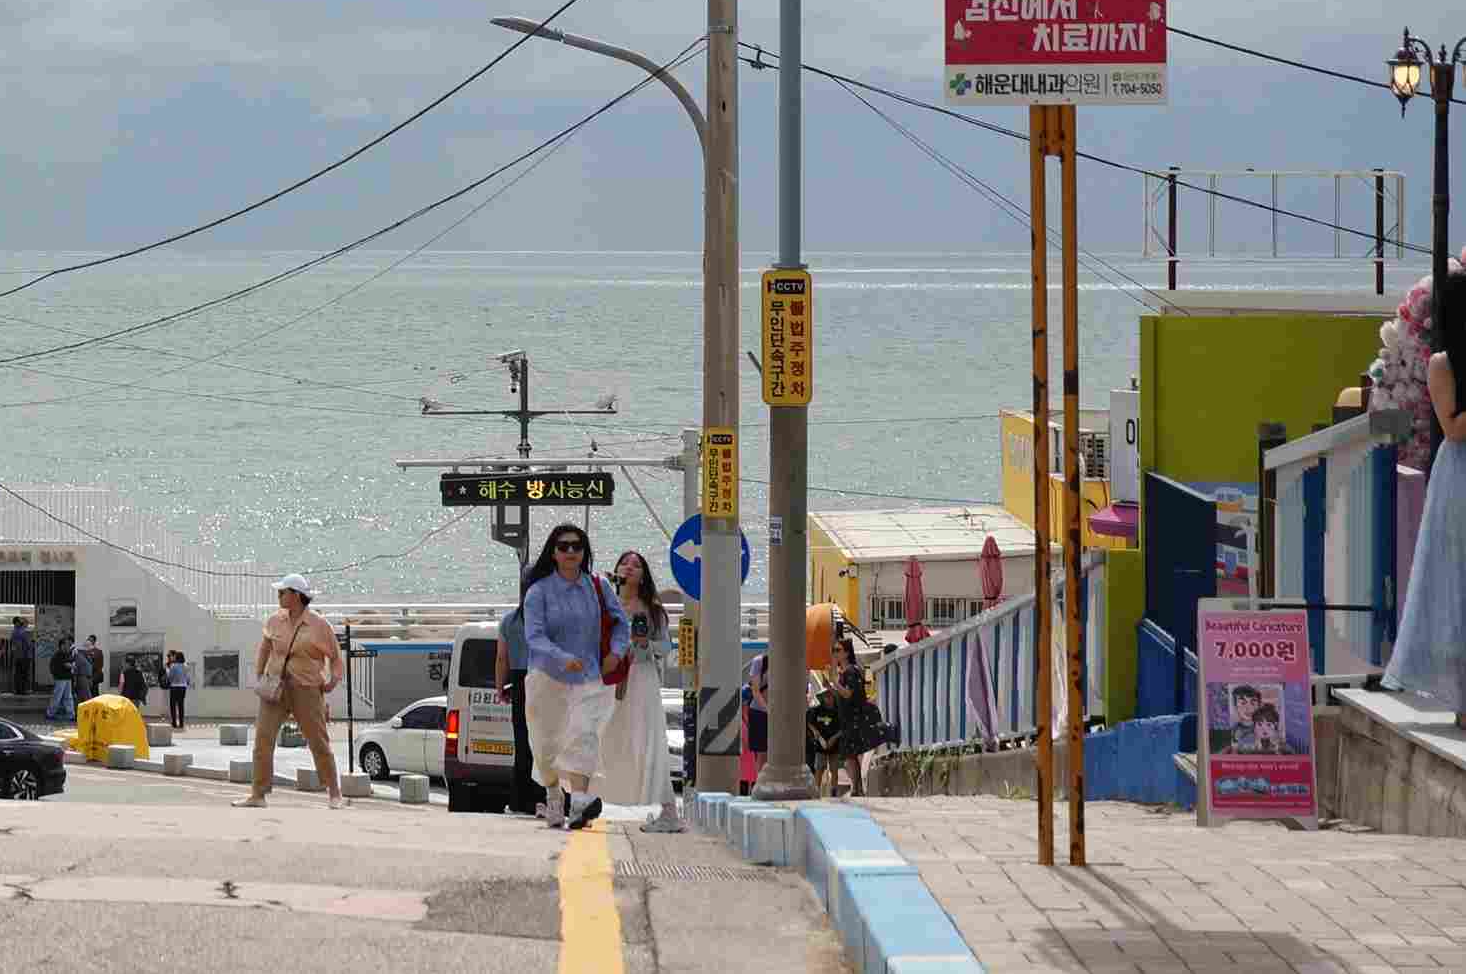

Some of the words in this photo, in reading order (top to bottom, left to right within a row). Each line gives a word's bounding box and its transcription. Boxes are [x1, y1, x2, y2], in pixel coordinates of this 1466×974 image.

[1032, 22, 1146, 53] 치료까지
[974, 73, 1101, 96] 해운대내과의원
[789, 300, 805, 397] 불법주정차
[526, 479, 604, 500] 방사능신
[1215, 639, 1296, 662] 7,000원
